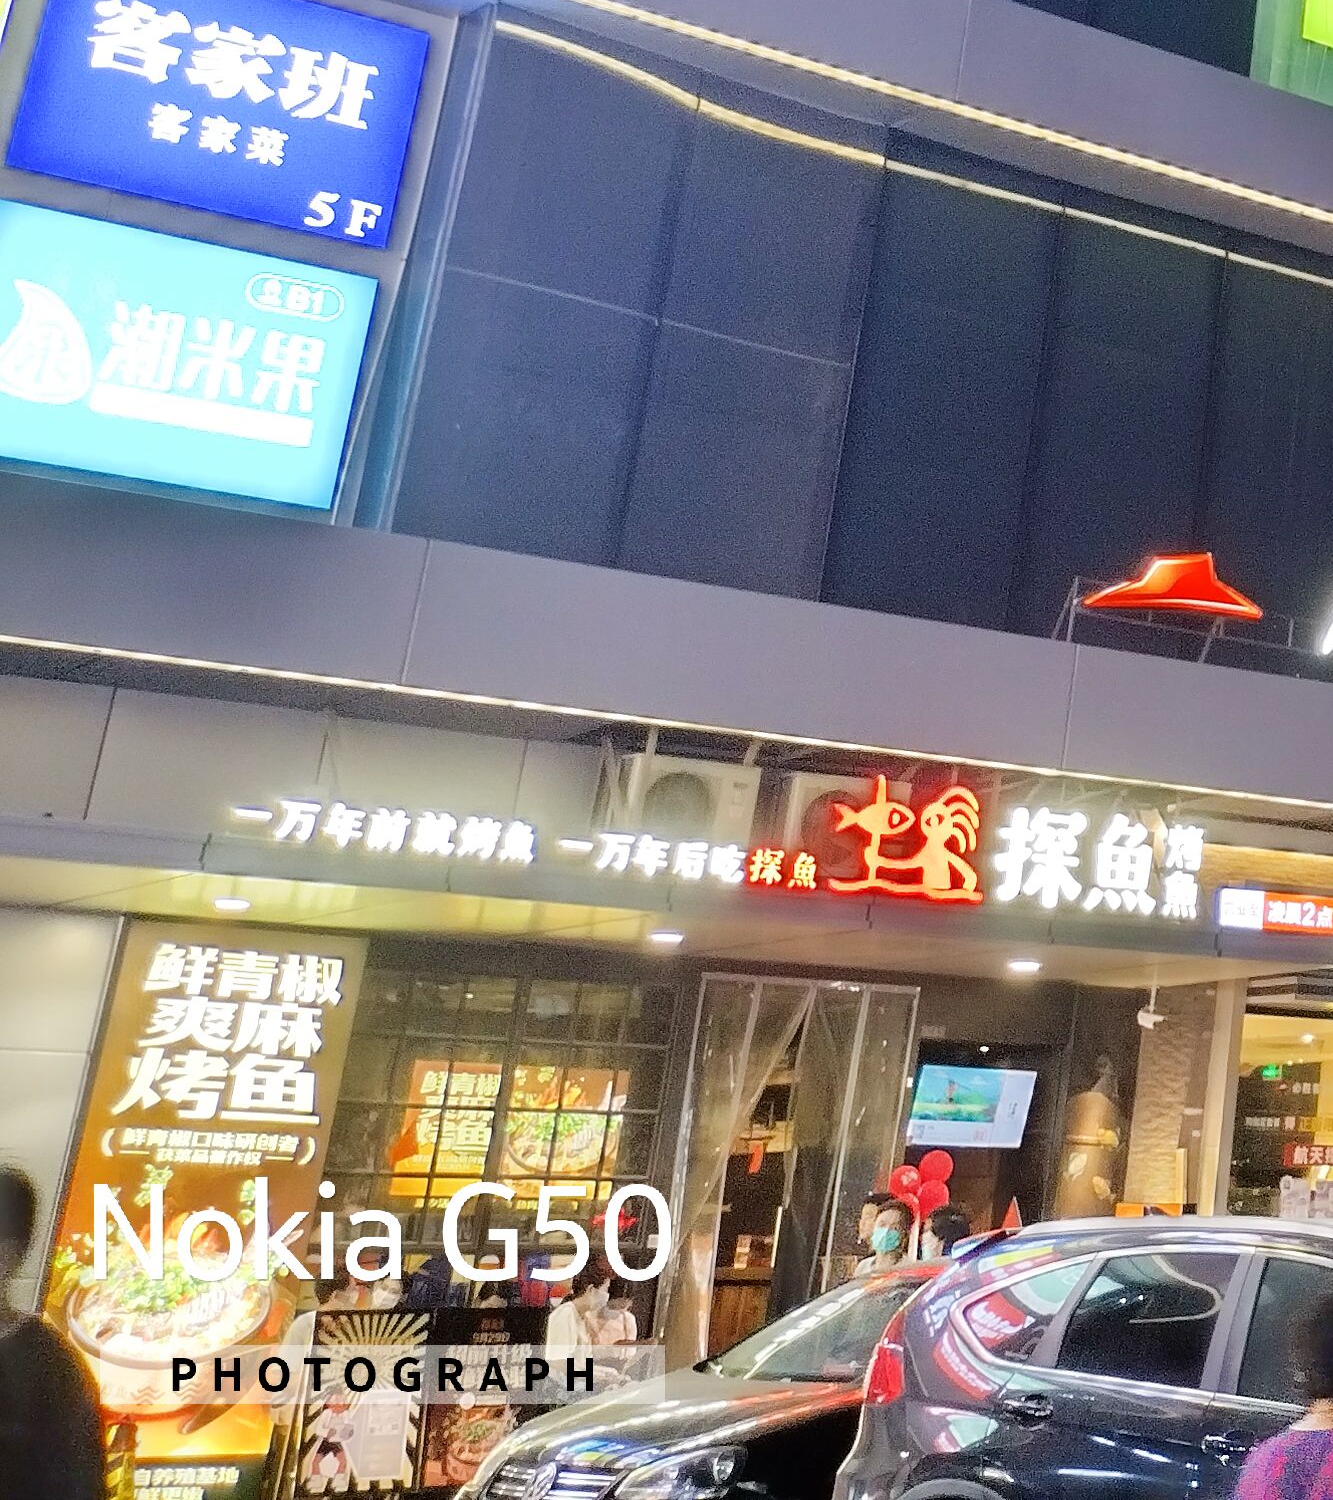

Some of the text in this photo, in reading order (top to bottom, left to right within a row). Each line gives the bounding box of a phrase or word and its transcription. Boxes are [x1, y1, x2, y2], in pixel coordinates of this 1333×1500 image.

[147, 102, 290, 167] 客家菜
[303, 191, 383, 238] 5F
[100, 300, 327, 413] 潮米果
[142, 943, 345, 1005] 鲜青椒
[138, 997, 324, 1058] 爽麻
[111, 1053, 320, 1126] 烤鱼
